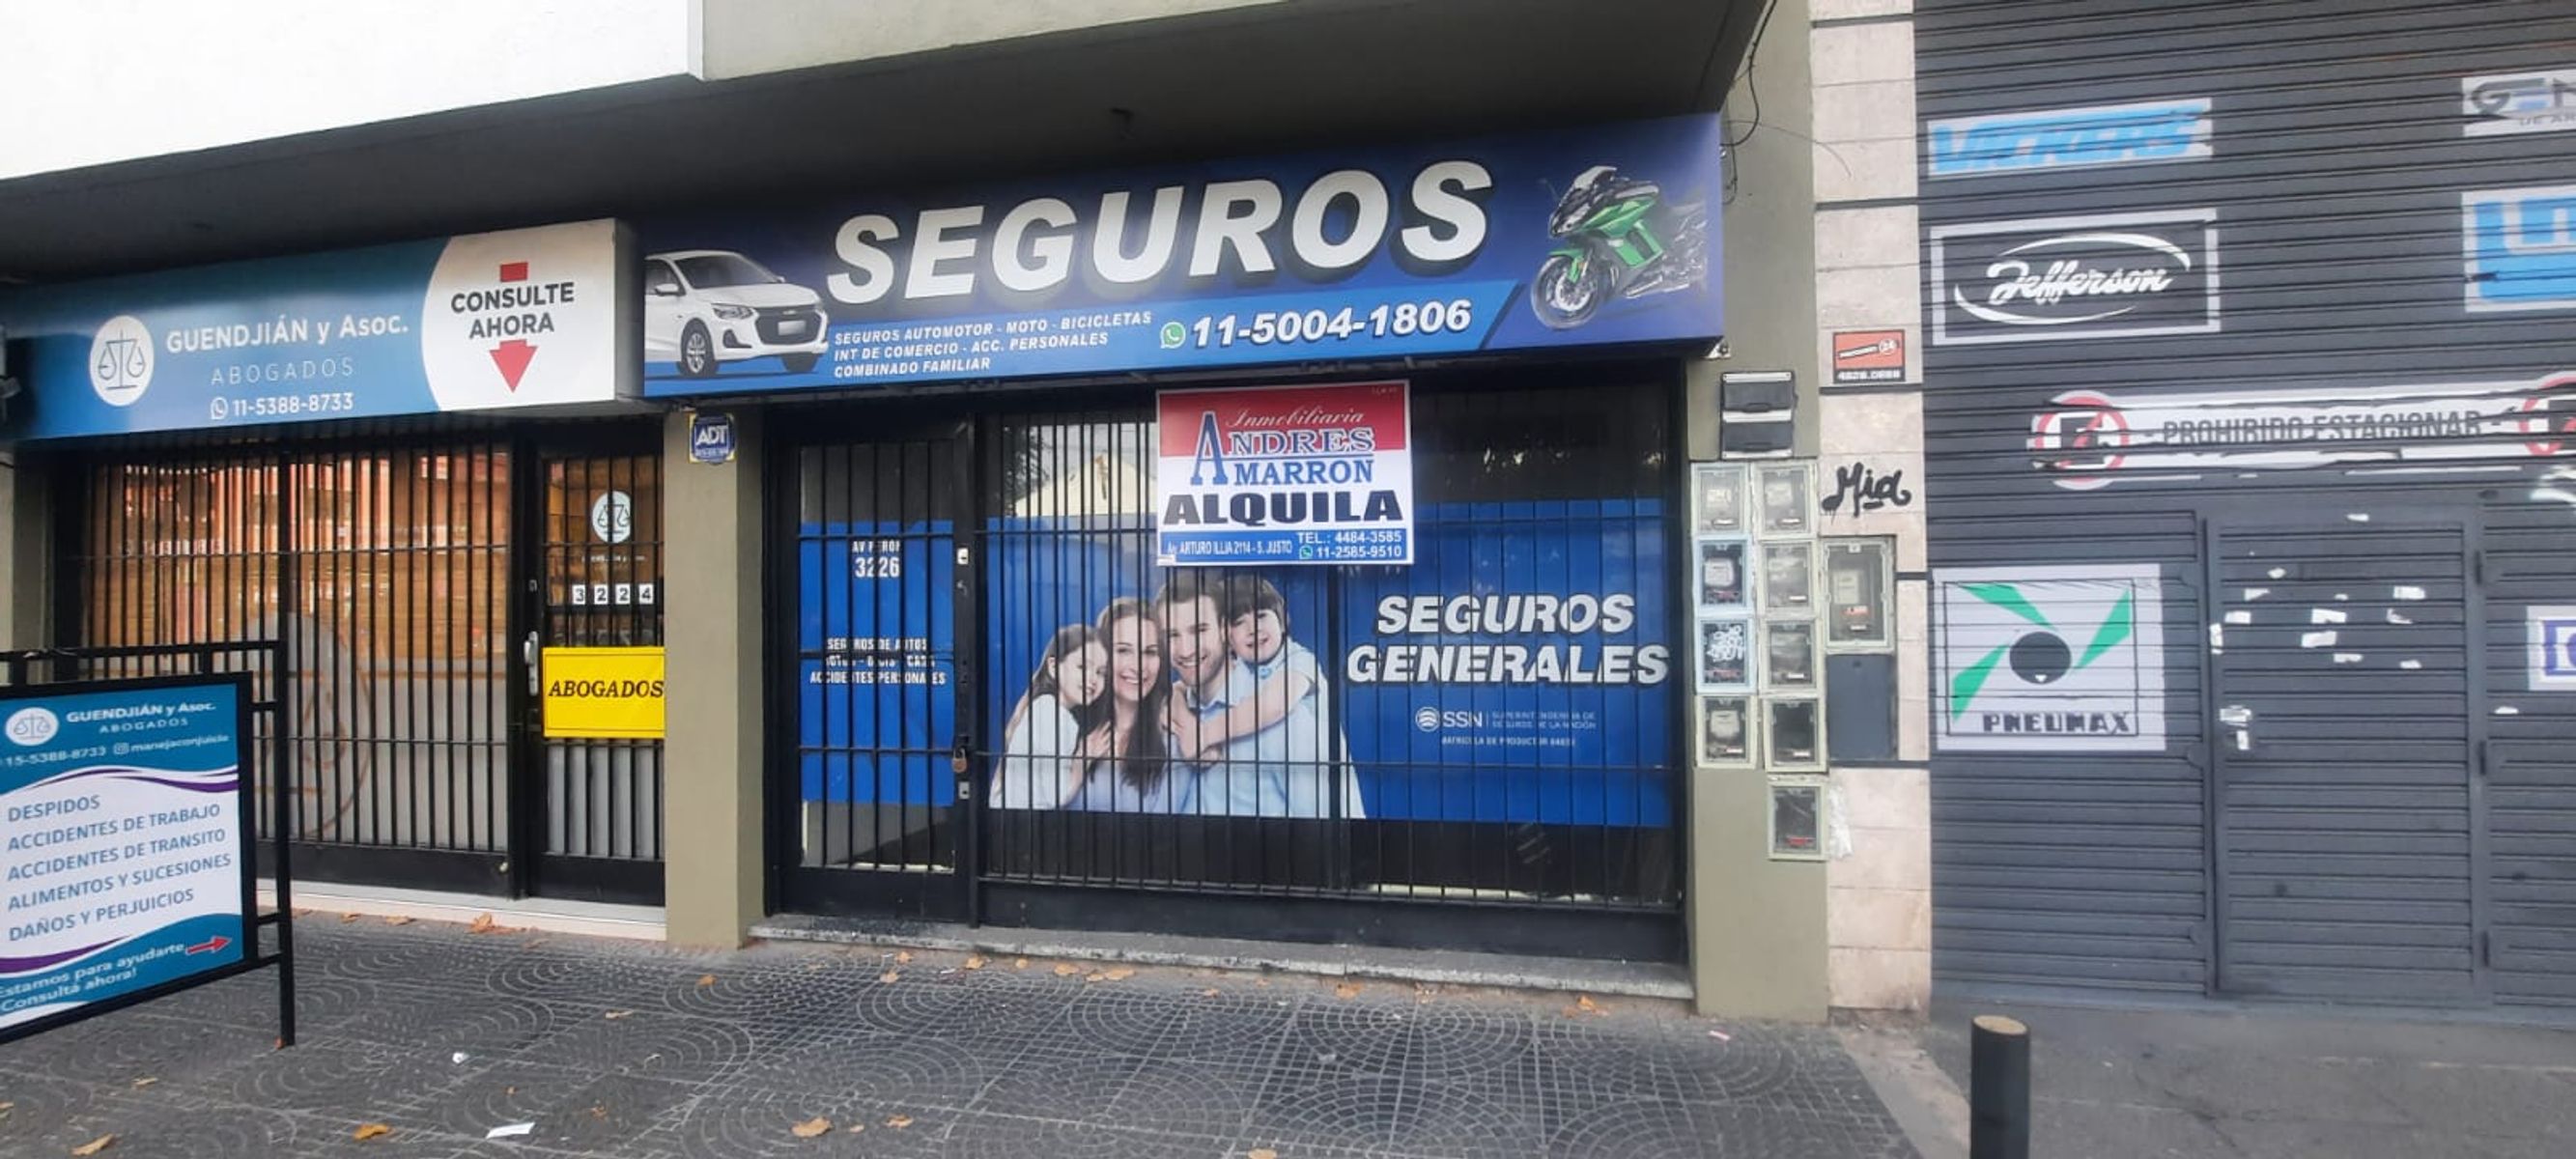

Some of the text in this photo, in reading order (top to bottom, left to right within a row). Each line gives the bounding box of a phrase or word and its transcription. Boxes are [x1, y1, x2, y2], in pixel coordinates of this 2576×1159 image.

[827, 160, 1492, 304] SEGUROS
[1986, 260, 2173, 305] Jefferson
[451, 281, 576, 314] CONSULTE
[165, 313, 410, 353] GUENDJIÁN y Asoc.
[468, 312, 555, 338] AHORA
[834, 327, 900, 346] SEGUROS
[904, 323, 994, 342] AUTOMOTOR
[1005, 320, 1047, 334] MOTO
[1061, 310, 1152, 330] BICICLETAS
[1192, 298, 1473, 348] 11-5004-1806
[834, 348, 859, 361] INT
[862, 346, 882, 359] DE
[884, 341, 959, 358] COMERCIO
[972, 338, 1005, 353] ACC.
[1009, 332, 1110, 351] PERSONALES
[210, 356, 356, 387] ABOGADOS
[834, 357, 991, 378] COMBINADO FAMILIAR
[233, 392, 355, 416] 11-5388-8733
[1225, 406, 1365, 428] Inmobiliaria
[695, 425, 727, 445] ADT
[1190, 410, 1375, 486] ANDRES
[1232, 460, 1374, 486] MARRON
[1163, 490, 1403, 527] ALQUILA
[852, 541, 865, 552] AV
[1335, 531, 1402, 543] 4484-3585
[855, 557, 900, 578] 3226
[576, 587, 651, 602] 3224
[1377, 593, 1635, 634] SEGUROS
[1347, 644, 1669, 684] GENERALES
[548, 680, 665, 698] ABOGADOS
[66, 702, 216, 722] GUENDJIÁN y Asoc.
[99, 718, 188, 734] ABOGADOS
[1443, 711, 1483, 727] SSN
[1982, 712, 2130, 734] PNEUMAX
[6, 746, 107, 767] 15-5388-8733
[8, 795, 100, 823] DESPIDOS
[8, 804, 220, 852] ACCIDENTES DE TRABAJO
[8, 829, 226, 882] ACCIDENTES DE TRANSITO
[8, 853, 232, 912] ALIMENTOS Y SUCESIONES
[9, 888, 194, 942] DAÑOS Y PERJUICIOS
[74, 960, 113, 982] para
[117, 942, 184, 969] ayudarte
[85, 967, 137, 991] ahora!
